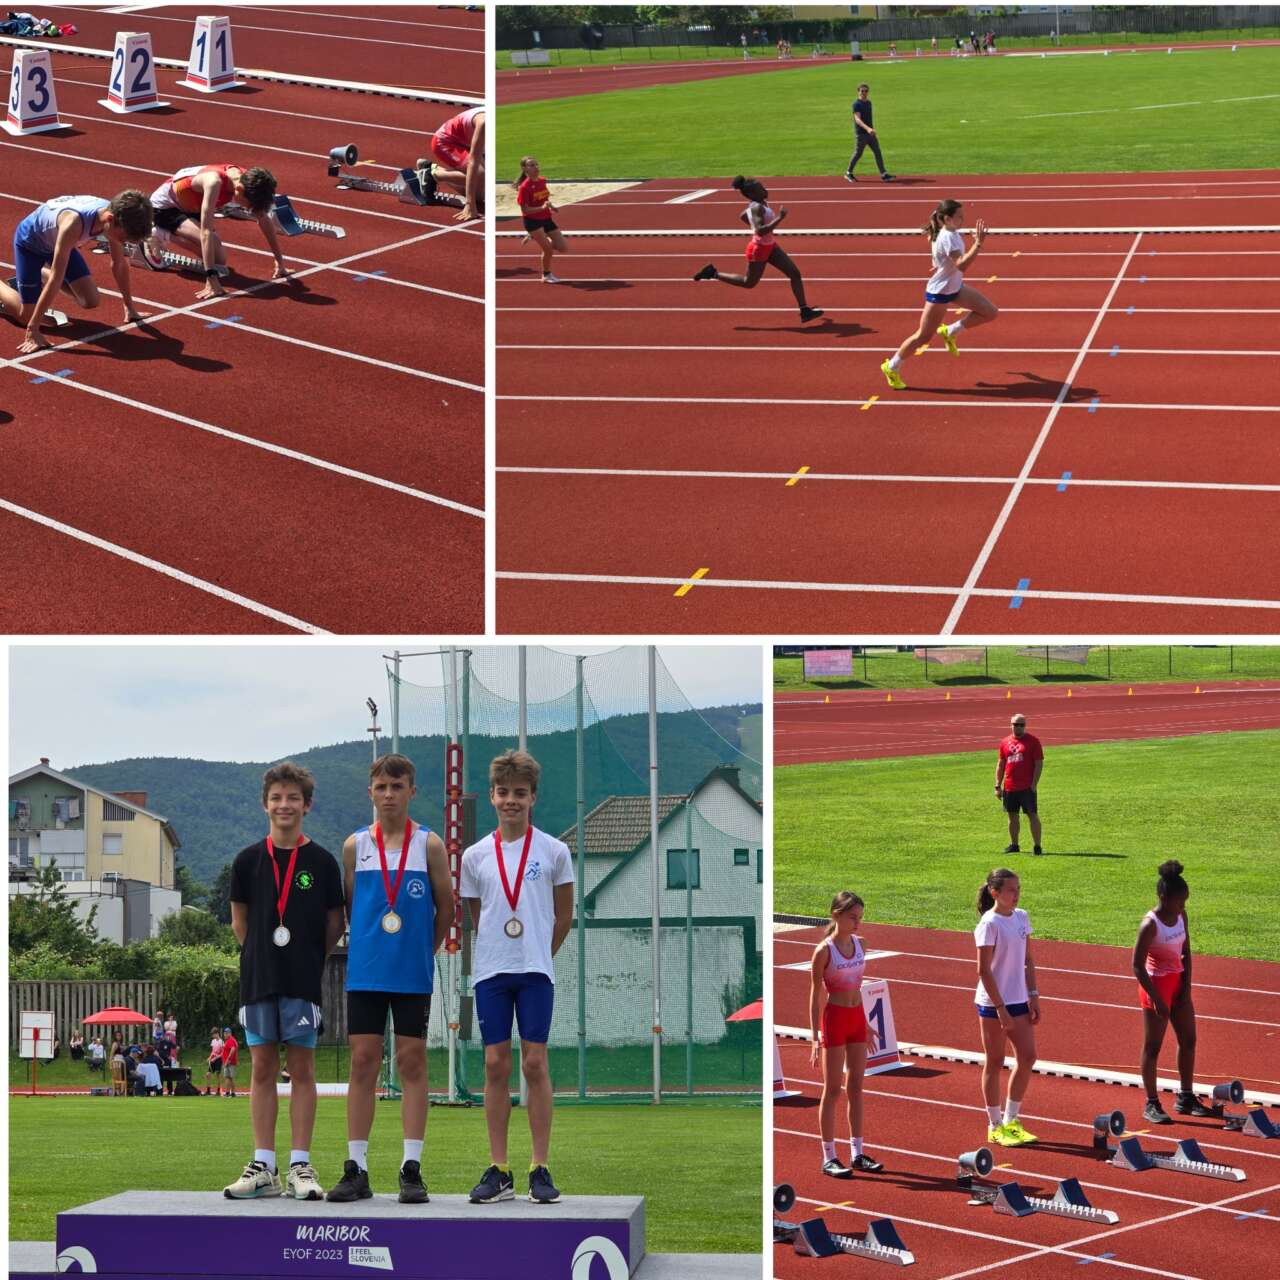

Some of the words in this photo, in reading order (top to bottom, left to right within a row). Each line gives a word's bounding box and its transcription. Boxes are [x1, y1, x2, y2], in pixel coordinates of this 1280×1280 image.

[112, 48, 124, 93] 2
[131, 47, 151, 93] 2
[196, 31, 207, 73] 1
[215, 30, 227, 72] 1
[12, 66, 20, 112] 3
[28, 66, 50, 113] 3
[869, 998, 886, 1050] 1
[283, 1248, 312, 1260] EYOF
[315, 1249, 343, 1260] 2023
[296, 1225, 371, 1242] MARIBOR
[351, 1255, 386, 1263] SLOVENIA
